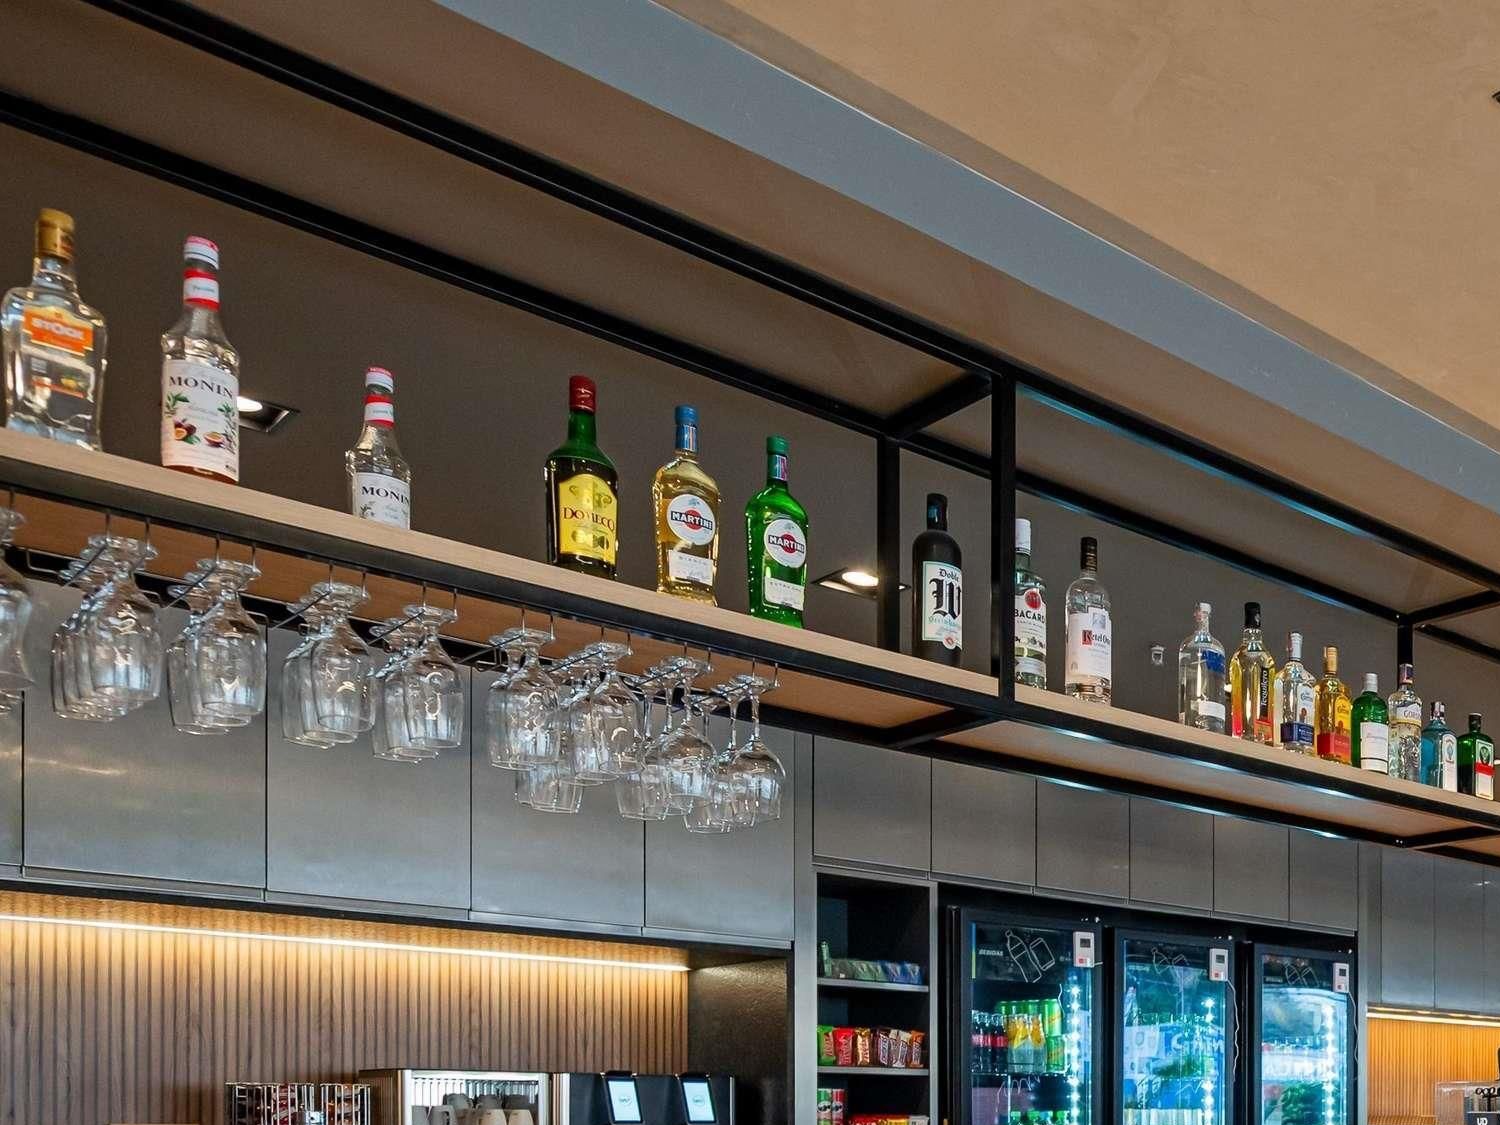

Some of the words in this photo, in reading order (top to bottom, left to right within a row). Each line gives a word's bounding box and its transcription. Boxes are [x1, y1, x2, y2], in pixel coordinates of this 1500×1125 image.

[169, 375, 233, 400] MONIN
[361, 485, 410, 505] MONIN
[671, 510, 713, 530] MARTINI
[769, 535, 805, 553] MARTINI
